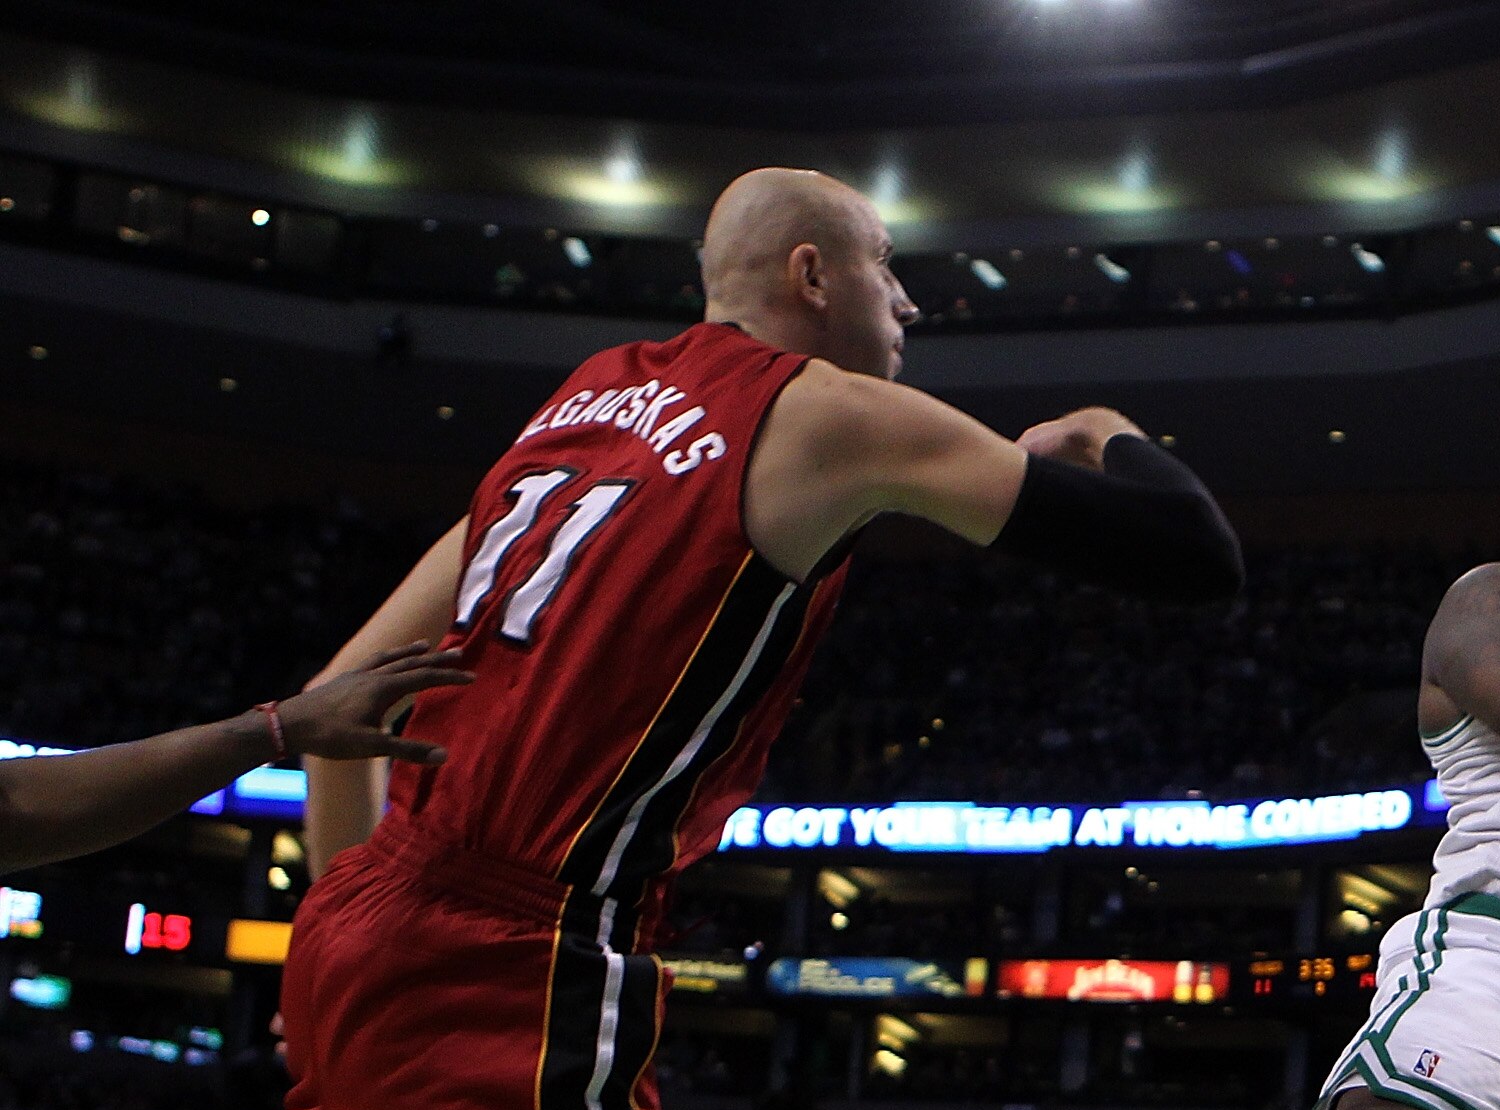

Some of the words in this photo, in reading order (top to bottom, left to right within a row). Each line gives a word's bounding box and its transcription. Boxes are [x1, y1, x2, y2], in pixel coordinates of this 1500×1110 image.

[515, 379, 727, 476] LGAUSKAS
[453, 466, 634, 643] 11
[763, 807, 847, 848] GOT
[850, 807, 962, 848] YOUR
[963, 807, 1072, 848] TEAM
[1075, 807, 1128, 847] AT
[1133, 805, 1250, 848] HOME
[1250, 789, 1412, 839] COVERED
